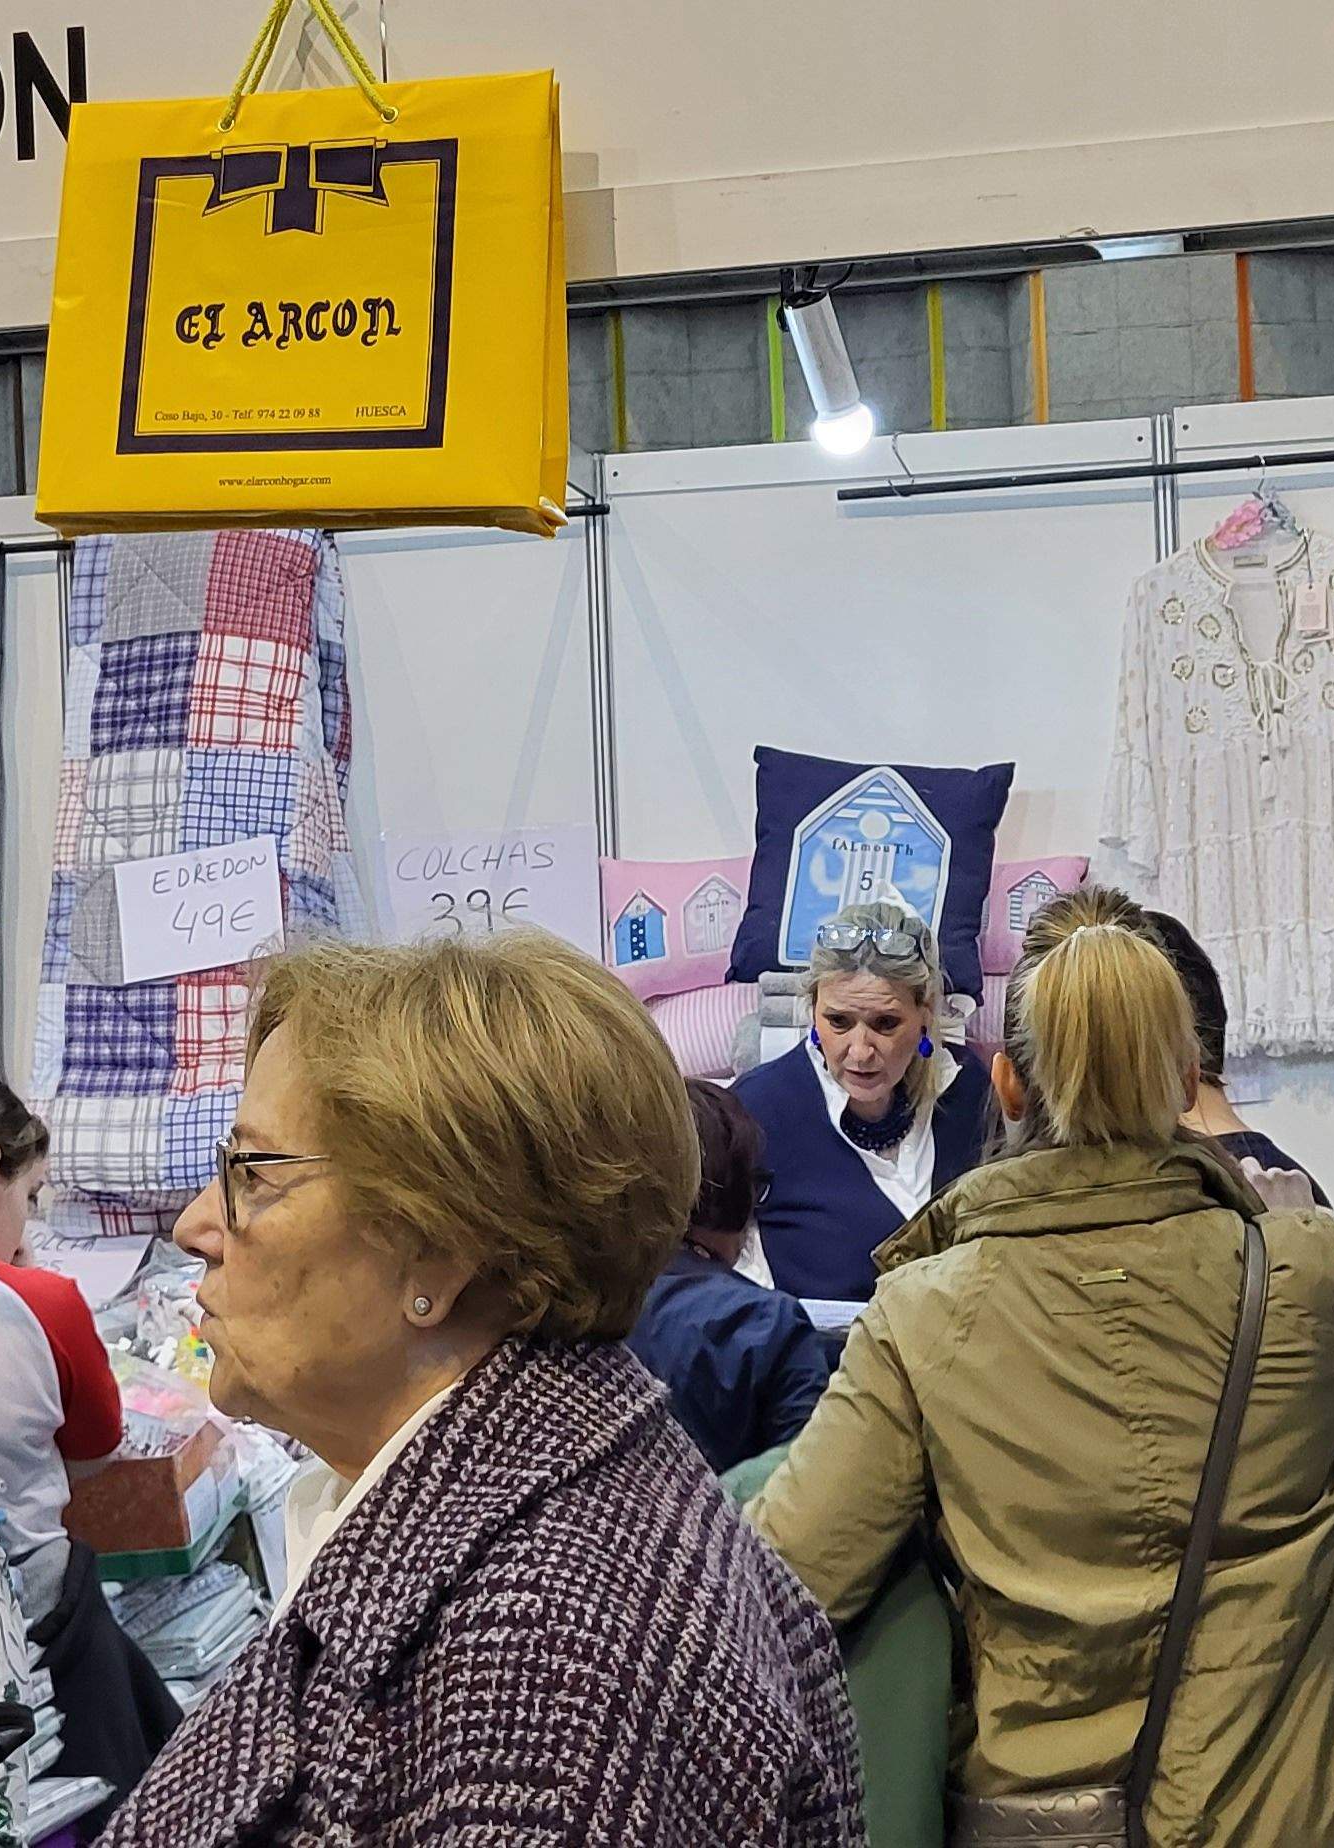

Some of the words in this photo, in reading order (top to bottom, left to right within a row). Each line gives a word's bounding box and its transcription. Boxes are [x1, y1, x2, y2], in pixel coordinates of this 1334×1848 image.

[241, 296, 402, 350] ARCON
[154, 410, 179, 421] Coso
[181, 410, 208, 423] Bajo,
[210, 410, 223, 421] 30
[257, 408, 276, 420] 974
[278, 408, 291, 420] 22
[292, 408, 306, 419] 09
[307, 407, 321, 418] 88
[355, 406, 407, 418] HUESCA
[218, 474, 332, 489] www.elarconhogar.com
[152, 853, 268, 895] EDREDON
[396, 840, 556, 883] COLCHAS
[859, 870, 875, 892] 5
[171, 899, 256, 945] 49€
